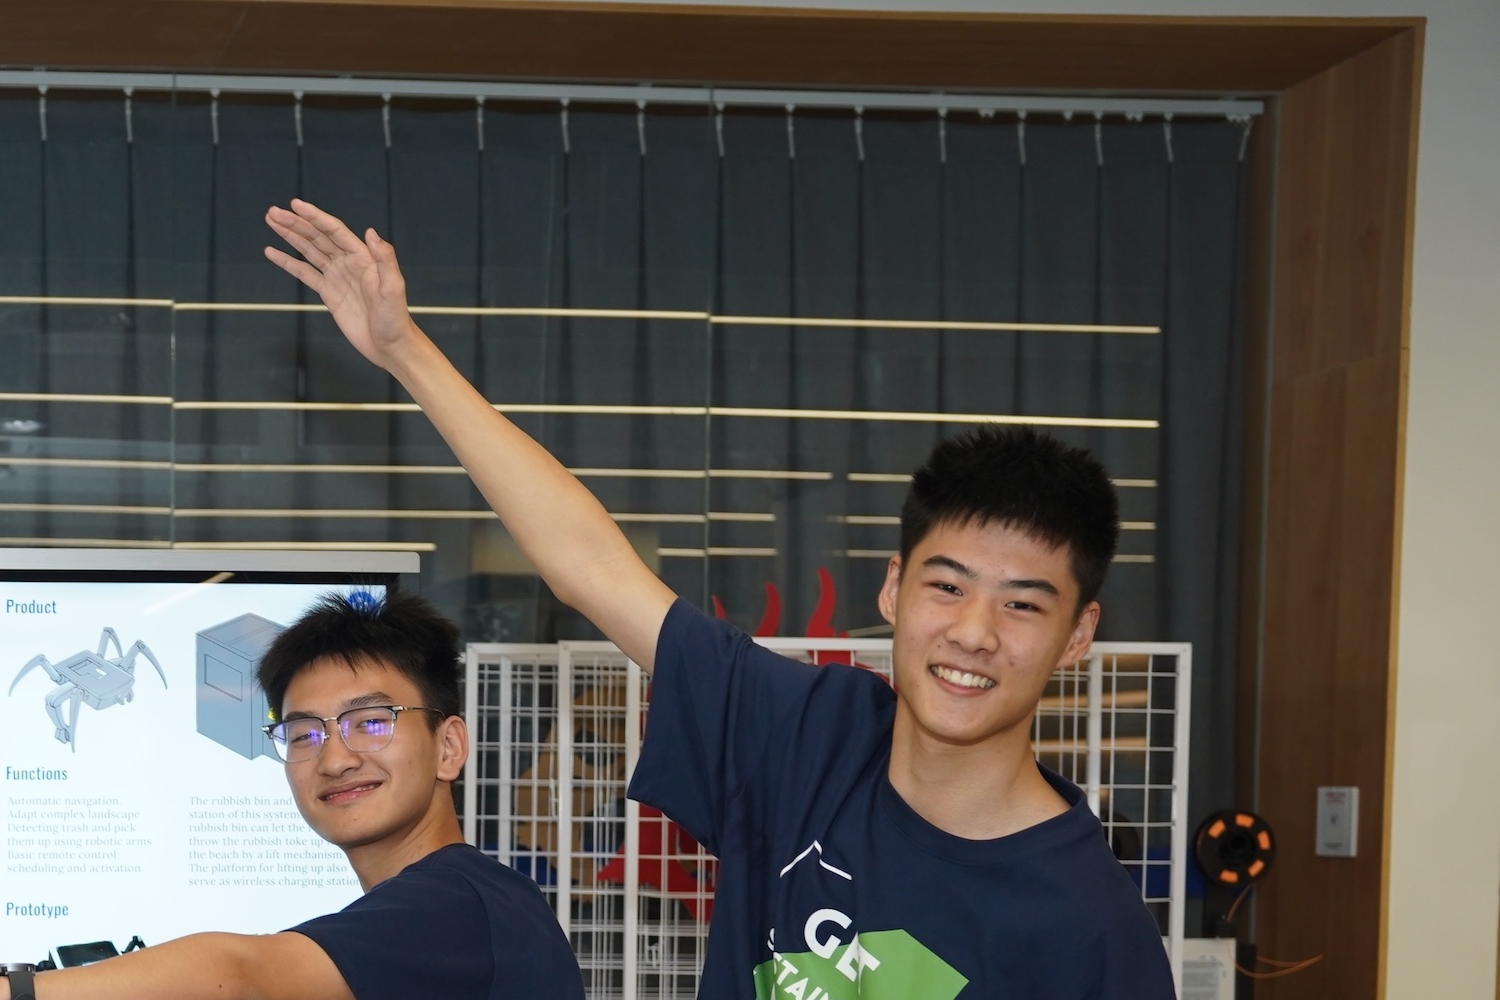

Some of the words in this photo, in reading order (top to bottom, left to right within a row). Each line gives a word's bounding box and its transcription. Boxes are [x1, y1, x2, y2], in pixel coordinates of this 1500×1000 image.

[6, 599, 57, 614] Product
[6, 766, 68, 781] Functions
[7, 810, 37, 821] Adapt
[40, 810, 85, 821] complex
[88, 810, 140, 821] landscape
[189, 863, 208, 873] The
[212, 863, 256, 875] platform
[259, 863, 274, 873] for
[277, 863, 308, 875] lifting
[311, 865, 324, 875] up
[327, 863, 347, 873] also
[233, 877, 275, 886] wireless
[278, 877, 324, 888] charging
[6, 902, 69, 919] Prototype
